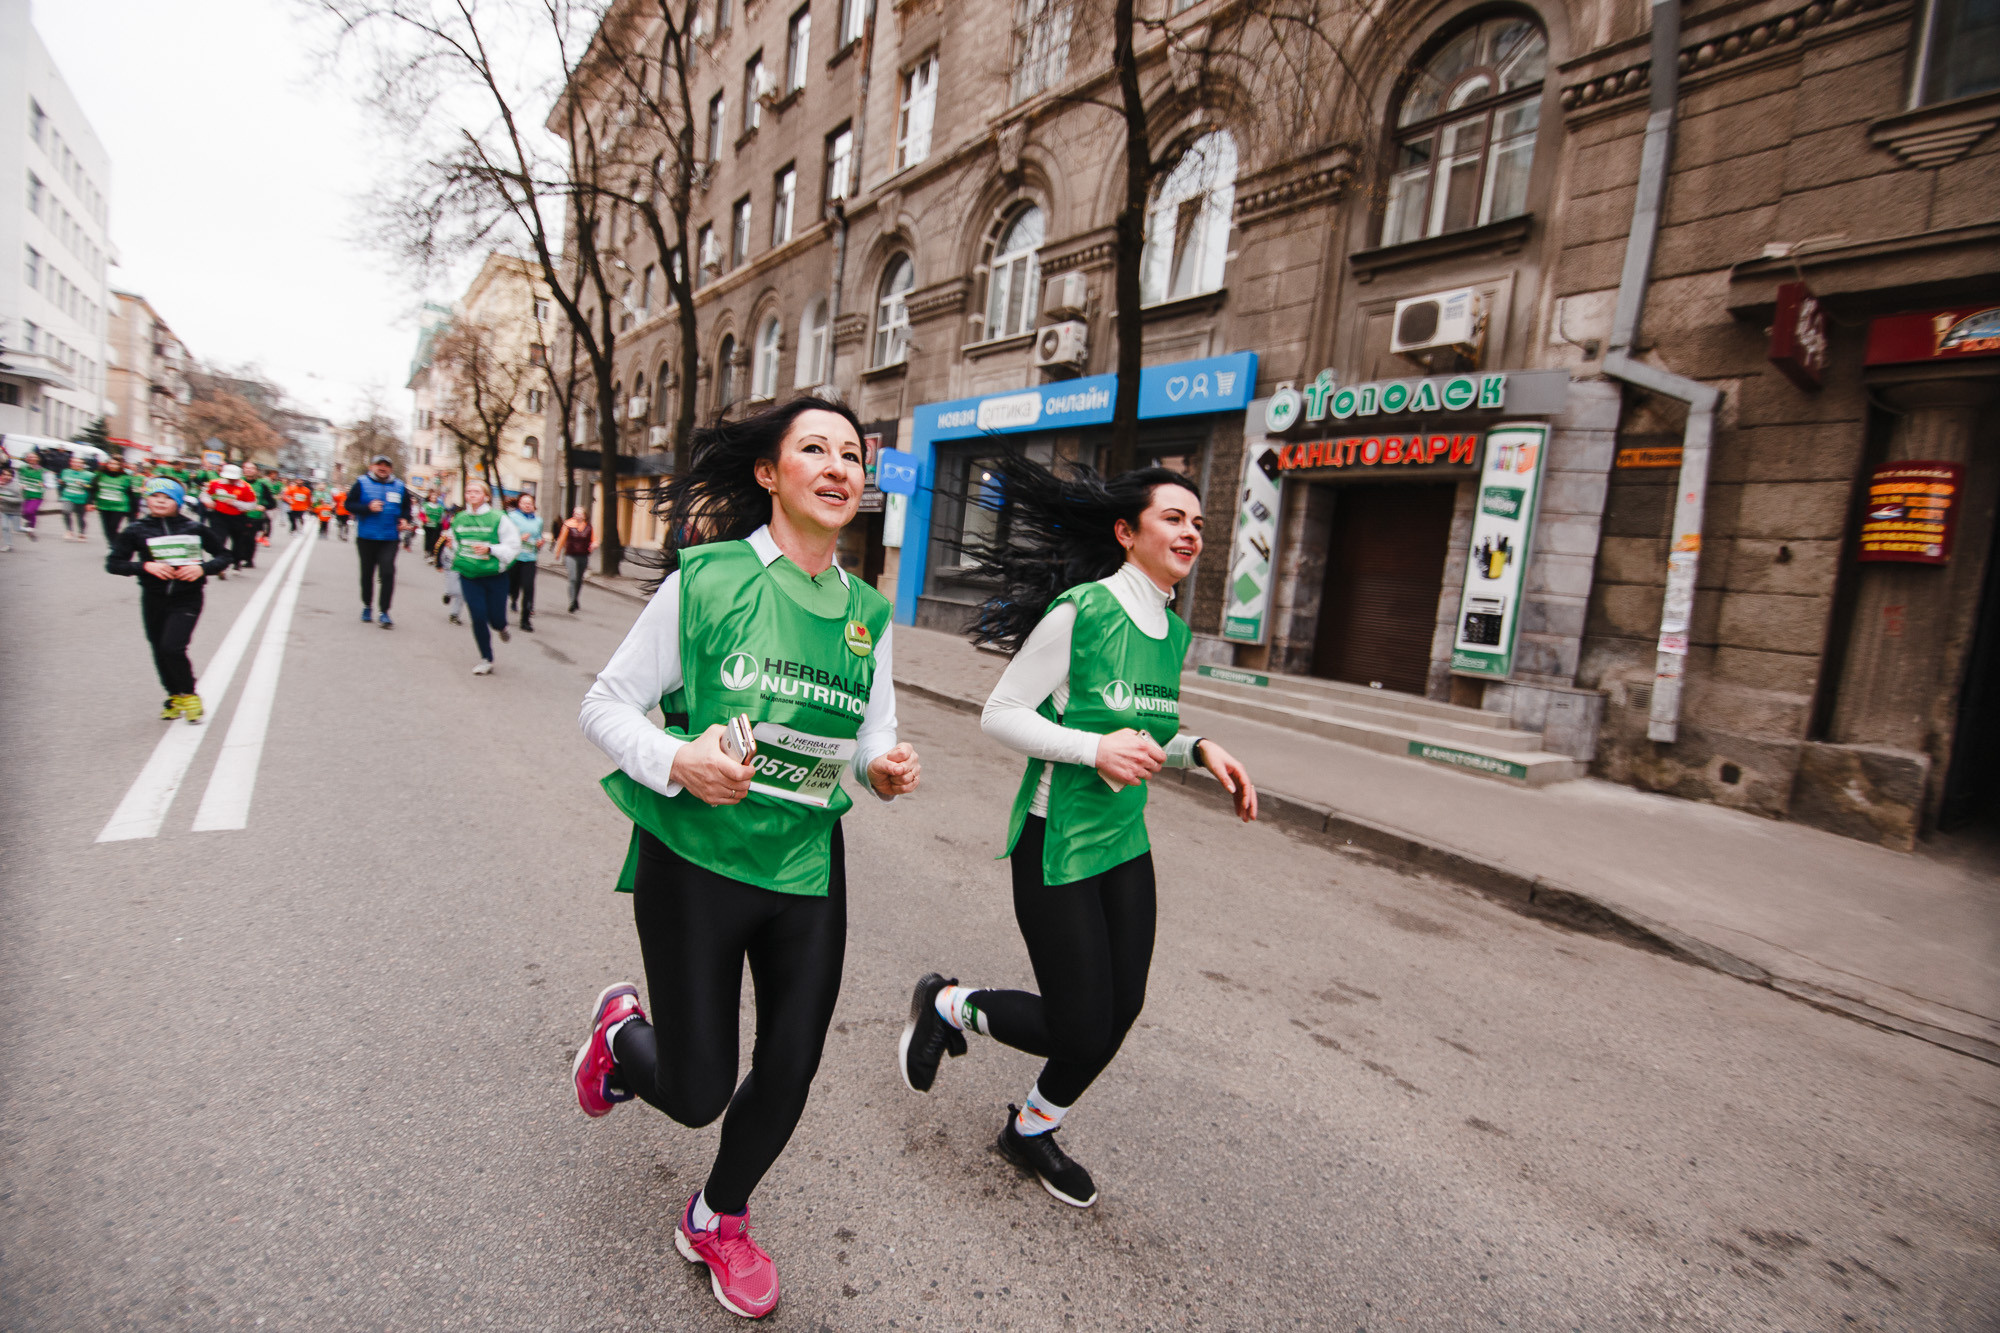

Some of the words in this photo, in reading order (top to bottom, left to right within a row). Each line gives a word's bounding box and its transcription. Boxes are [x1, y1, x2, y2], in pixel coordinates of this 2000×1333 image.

[937, 409, 976, 429] новая
[982, 400, 1032, 422] оптика
[1045, 386, 1110, 415] онлайн
[1277, 433, 1478, 470] КАНЦТОВАРИ
[760, 692, 771, 701] Мы
[790, 743, 837, 756] NUTRITION
[794, 737, 841, 751] HERBALIFE
[749, 754, 809, 783] 0578
[819, 763, 843, 771] FAMILY
[812, 768, 840, 780] RUN
[805, 779, 817, 788] 1,6
